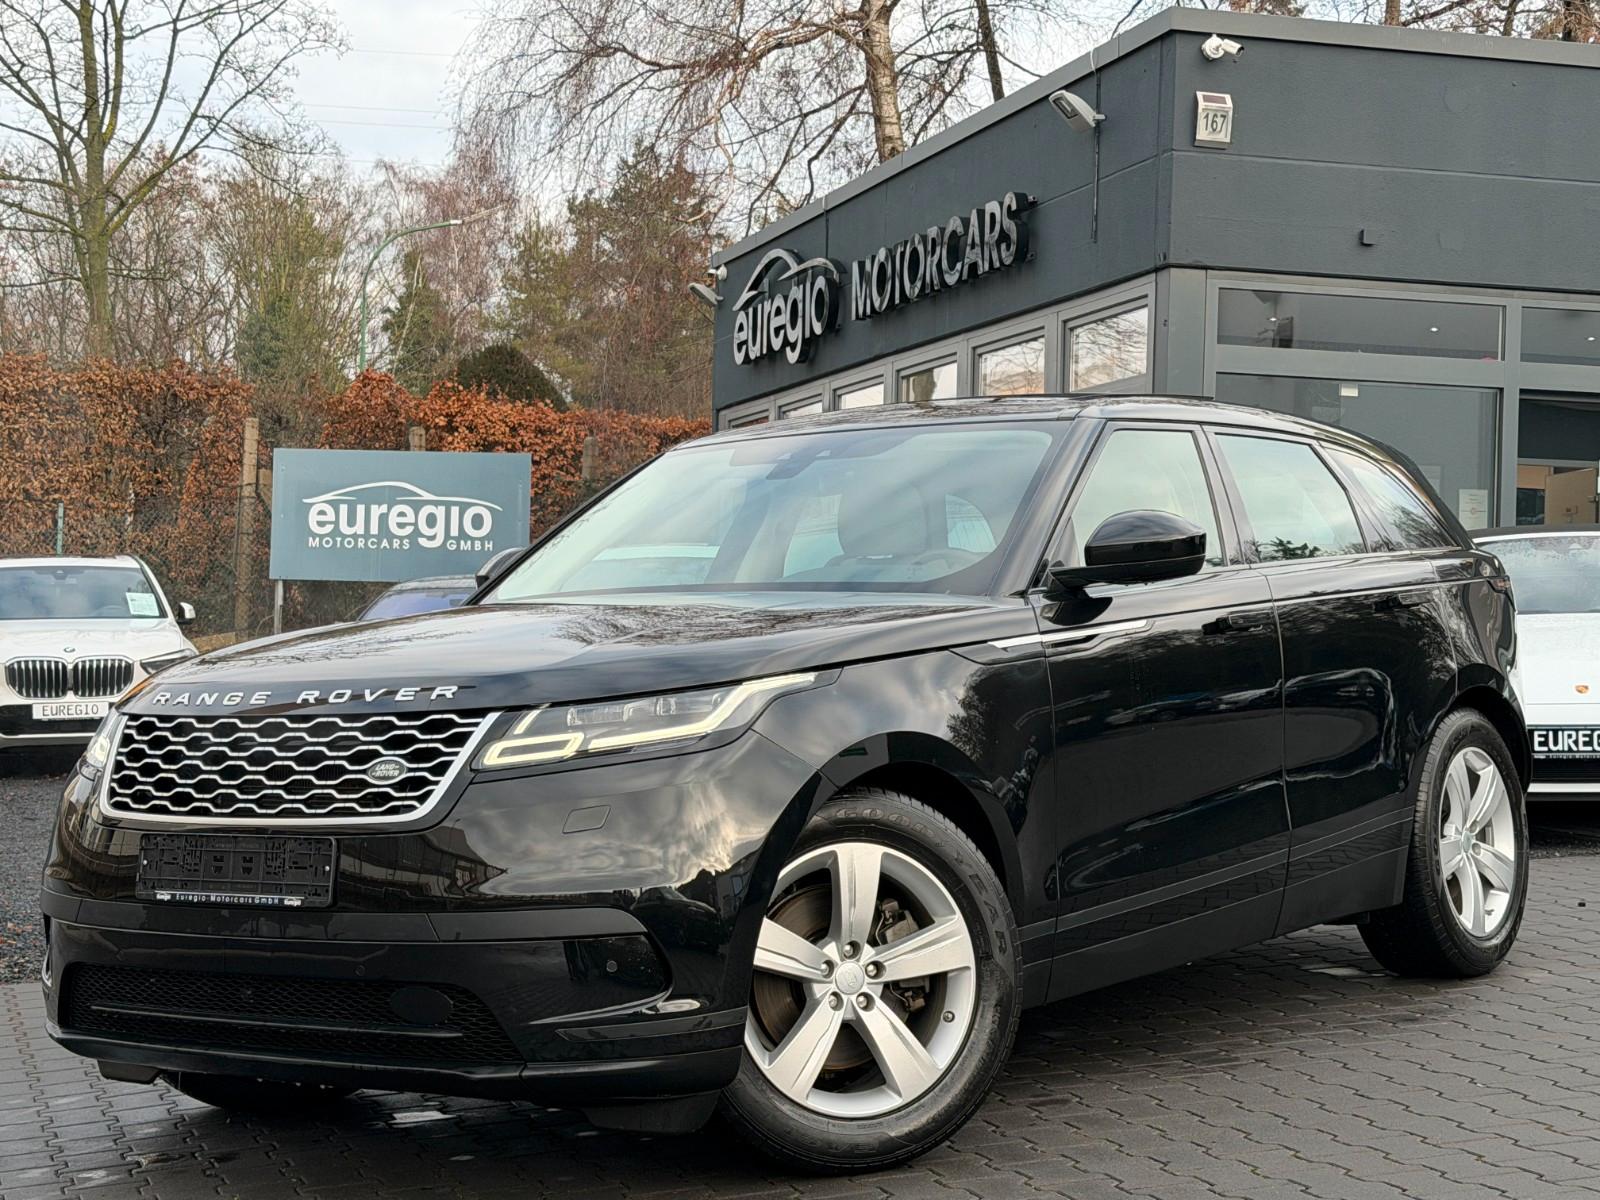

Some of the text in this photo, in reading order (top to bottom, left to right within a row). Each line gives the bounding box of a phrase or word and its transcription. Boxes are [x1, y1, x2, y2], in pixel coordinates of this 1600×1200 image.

[1203, 112, 1227, 134] 167
[733, 191, 1018, 365] euregio MOTORCARS
[308, 502, 493, 548] euregio
[308, 536, 493, 551] MOTORCARS GMBH
[152, 685, 459, 706] RANGE ROVER
[42, 703, 99, 718] EUREGIO
